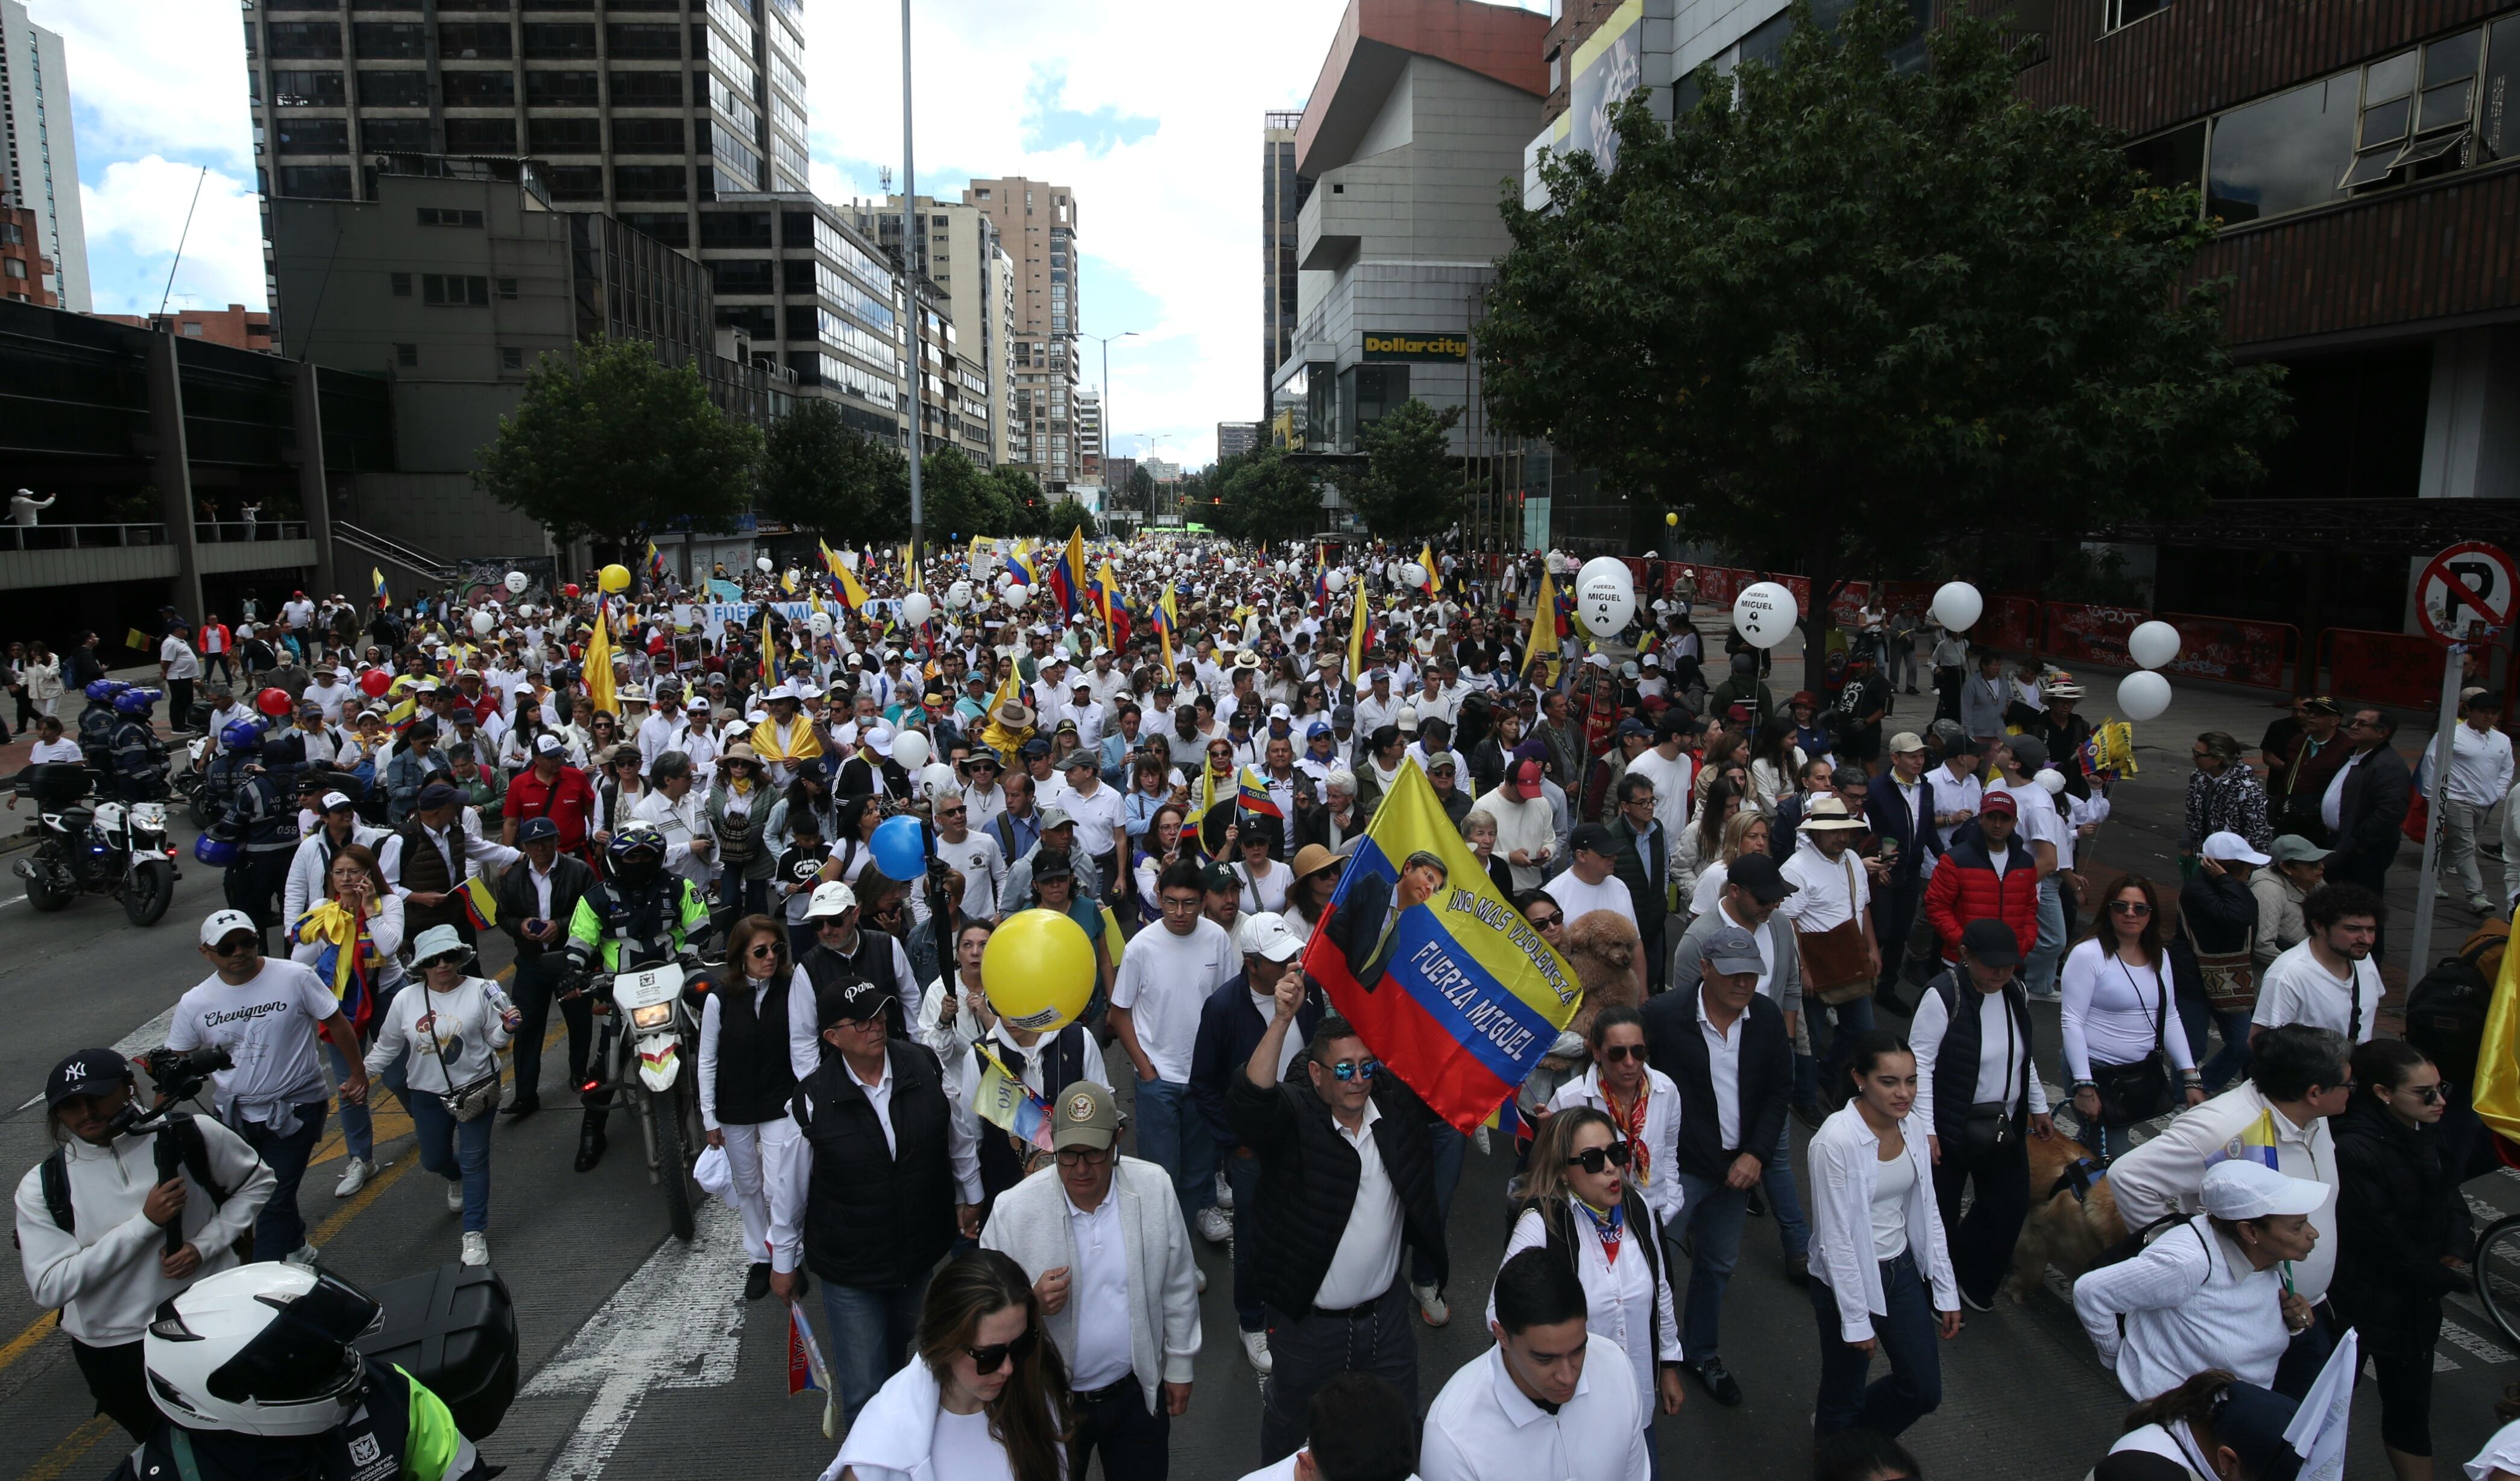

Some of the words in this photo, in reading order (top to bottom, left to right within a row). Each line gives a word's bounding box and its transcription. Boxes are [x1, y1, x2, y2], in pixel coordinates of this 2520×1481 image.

[1365, 336, 1467, 358] Dollarcity
[1587, 593, 1621, 602] MIGUEL
[1740, 599, 1774, 611] MIGUEL
[714, 605, 779, 622] FUER
[277, 826, 298, 835] 059
[1474, 897, 1515, 932] MAS
[1410, 939, 1479, 1011] FUERZA
[1465, 998, 1536, 1061] MIGUEL
[204, 1000, 288, 1027] Chevignon
[65, 1061, 86, 1082] NY
[162, 1095, 180, 1110] RONIN
